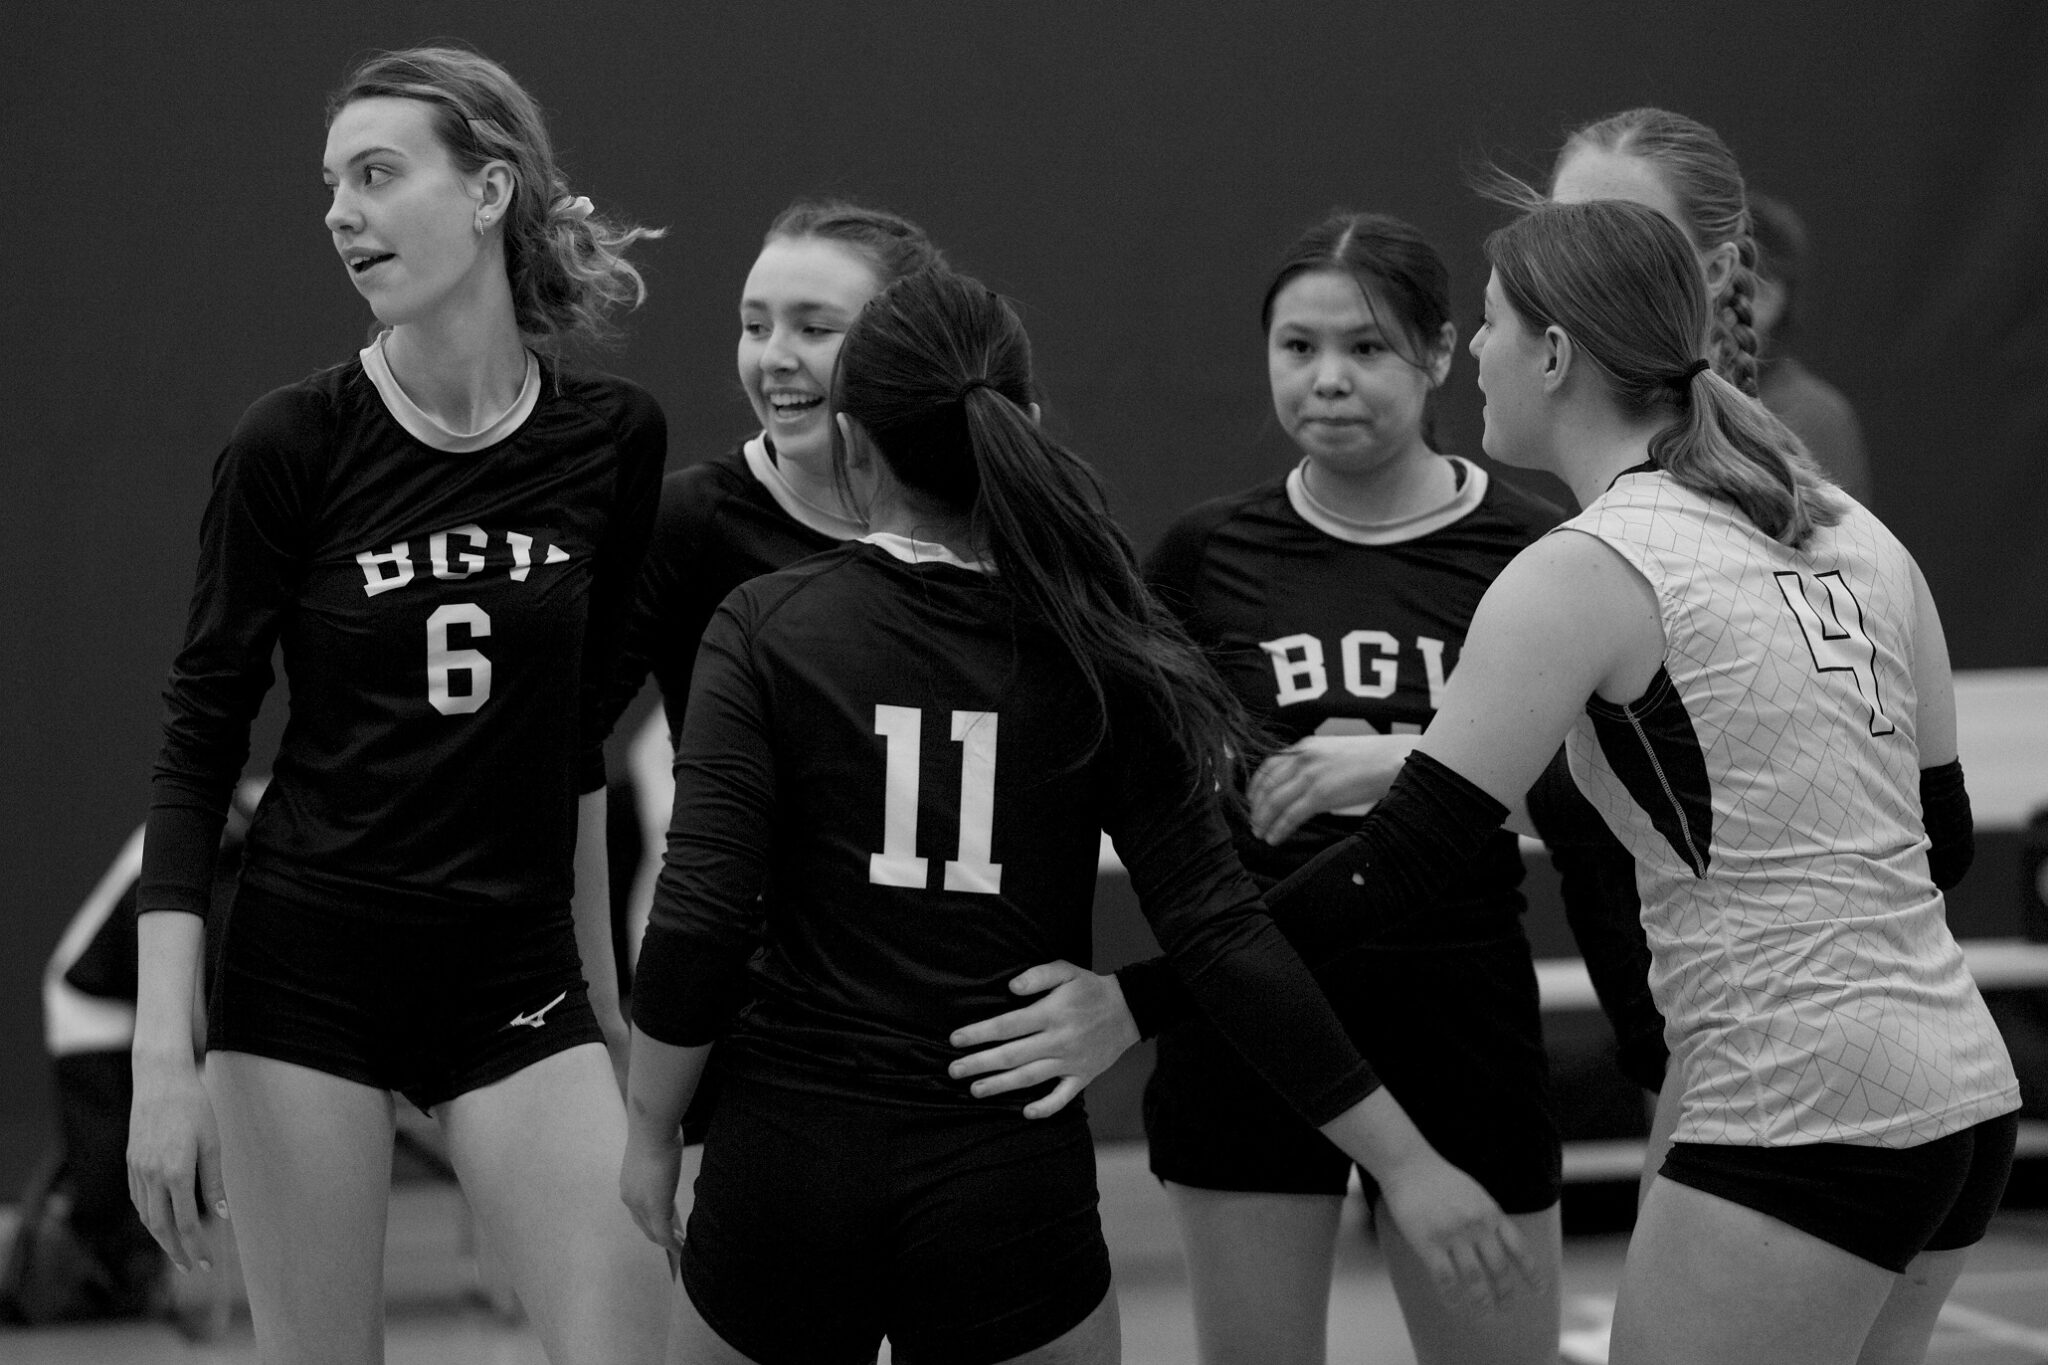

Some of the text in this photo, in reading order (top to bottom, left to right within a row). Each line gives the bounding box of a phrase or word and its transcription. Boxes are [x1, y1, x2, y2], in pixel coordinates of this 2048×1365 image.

[426, 603, 491, 716] 6
[1773, 570, 1895, 737] 4
[868, 704, 1003, 894] 11
